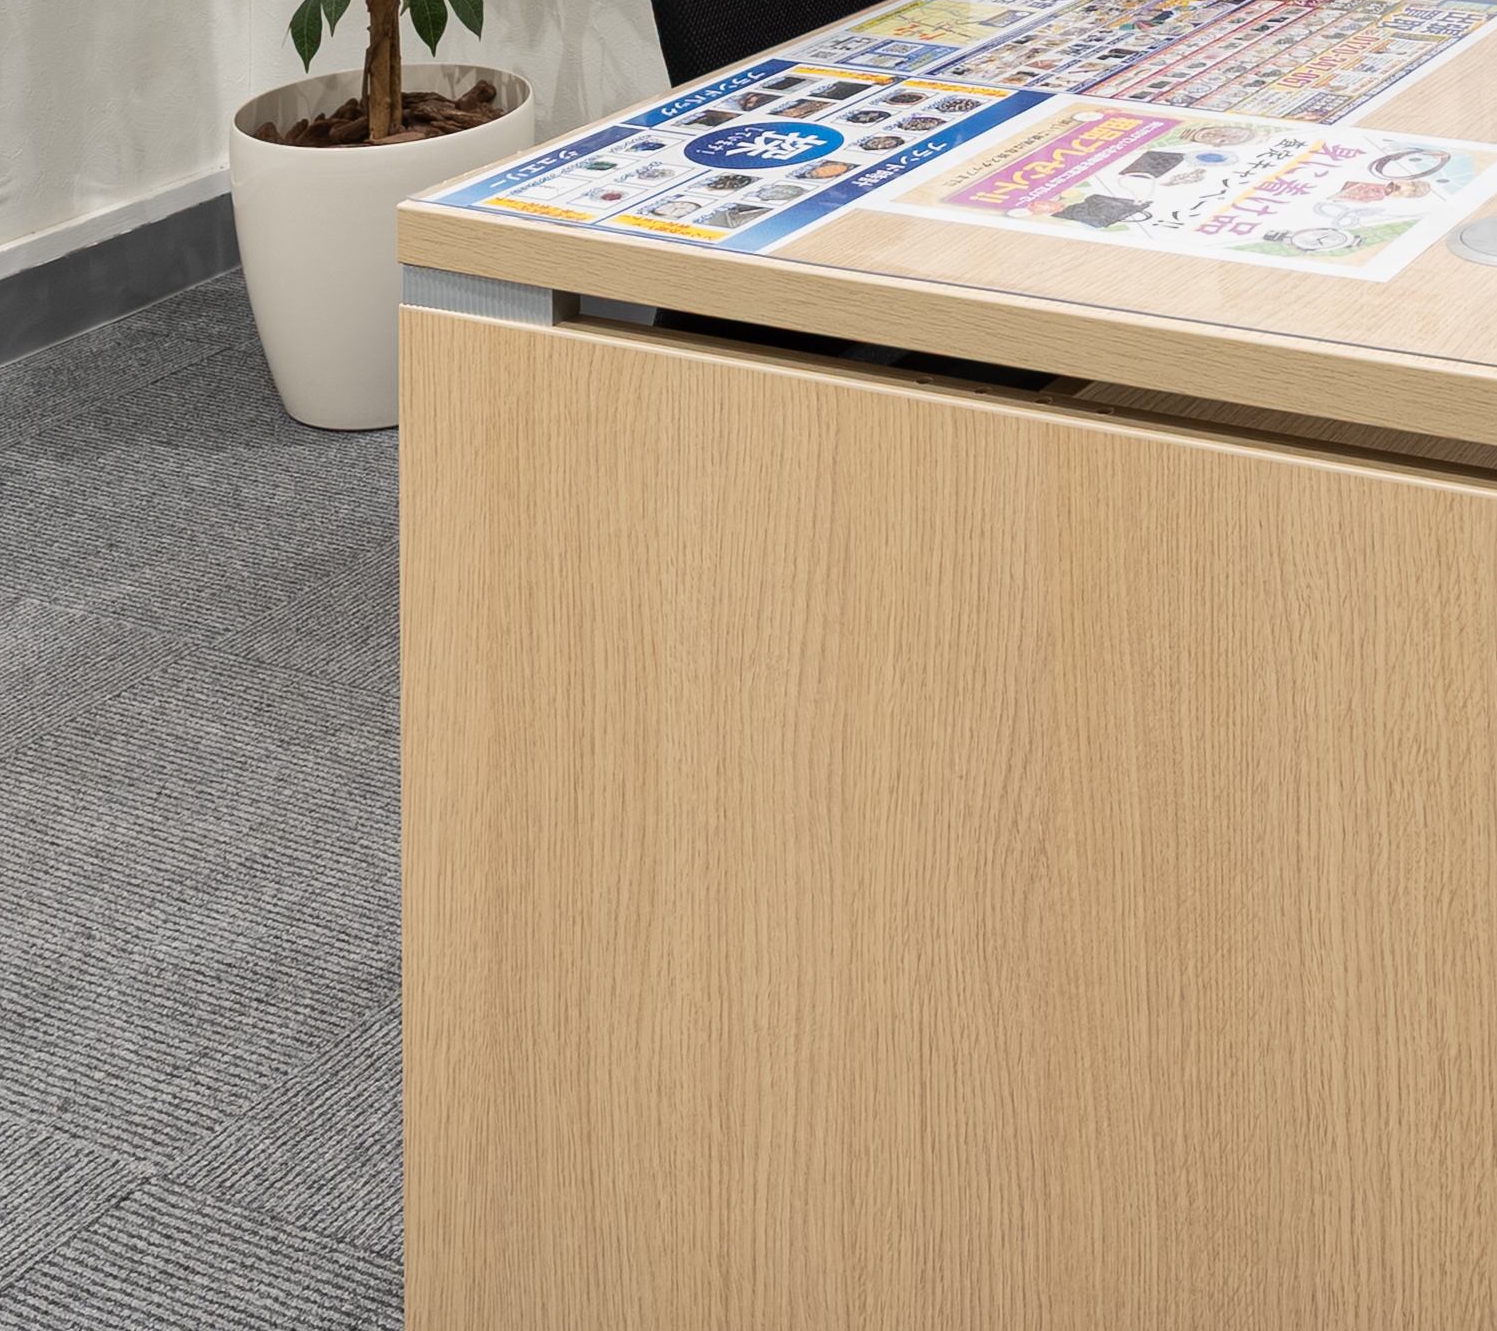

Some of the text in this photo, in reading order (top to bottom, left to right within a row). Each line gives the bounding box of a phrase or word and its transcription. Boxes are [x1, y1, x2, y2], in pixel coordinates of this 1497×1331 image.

[661, 71, 767, 116] ブランドバッグ
[490, 147, 579, 189] ジュエリー
[726, 133, 828, 161] 探
[852, 142, 946, 187] ブランド時計
[969, 115, 1142, 206] 粗品プレゼント!!
[1198, 141, 1356, 237] 身に着け品
